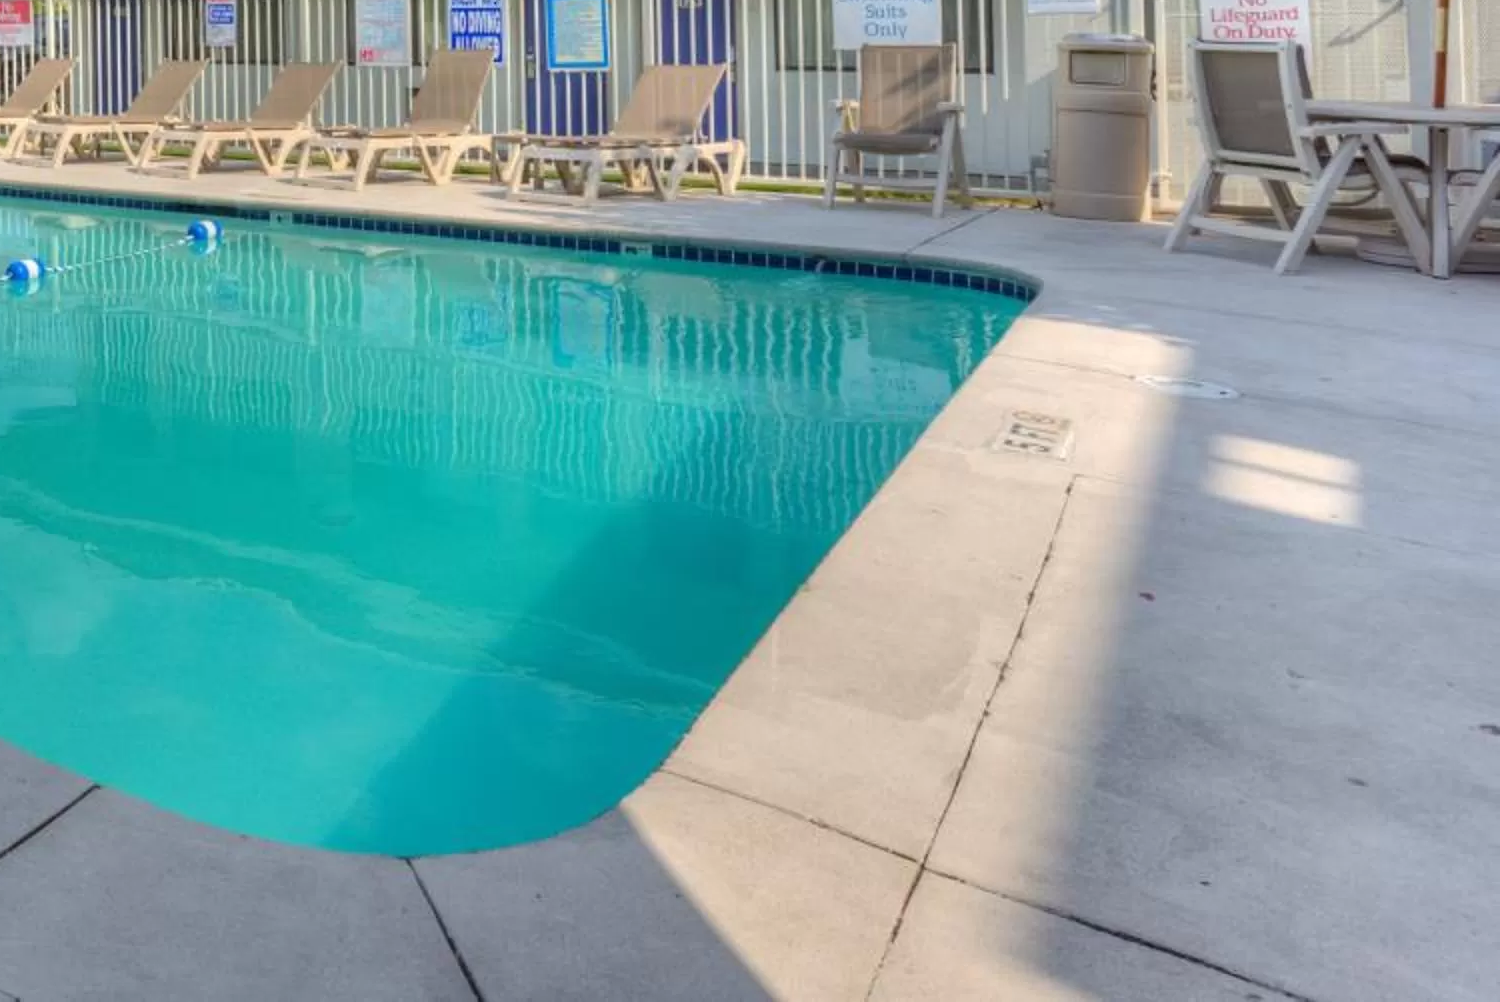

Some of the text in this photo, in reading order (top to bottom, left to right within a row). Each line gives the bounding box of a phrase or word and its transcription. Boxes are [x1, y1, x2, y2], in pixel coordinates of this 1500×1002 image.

[865, 4, 908, 19] Suits
[1210, 6, 1299, 25] Lifeguard
[452, 10, 501, 32] NO DIVING
[864, 21, 908, 38] Only
[1213, 25, 1243, 39] On
